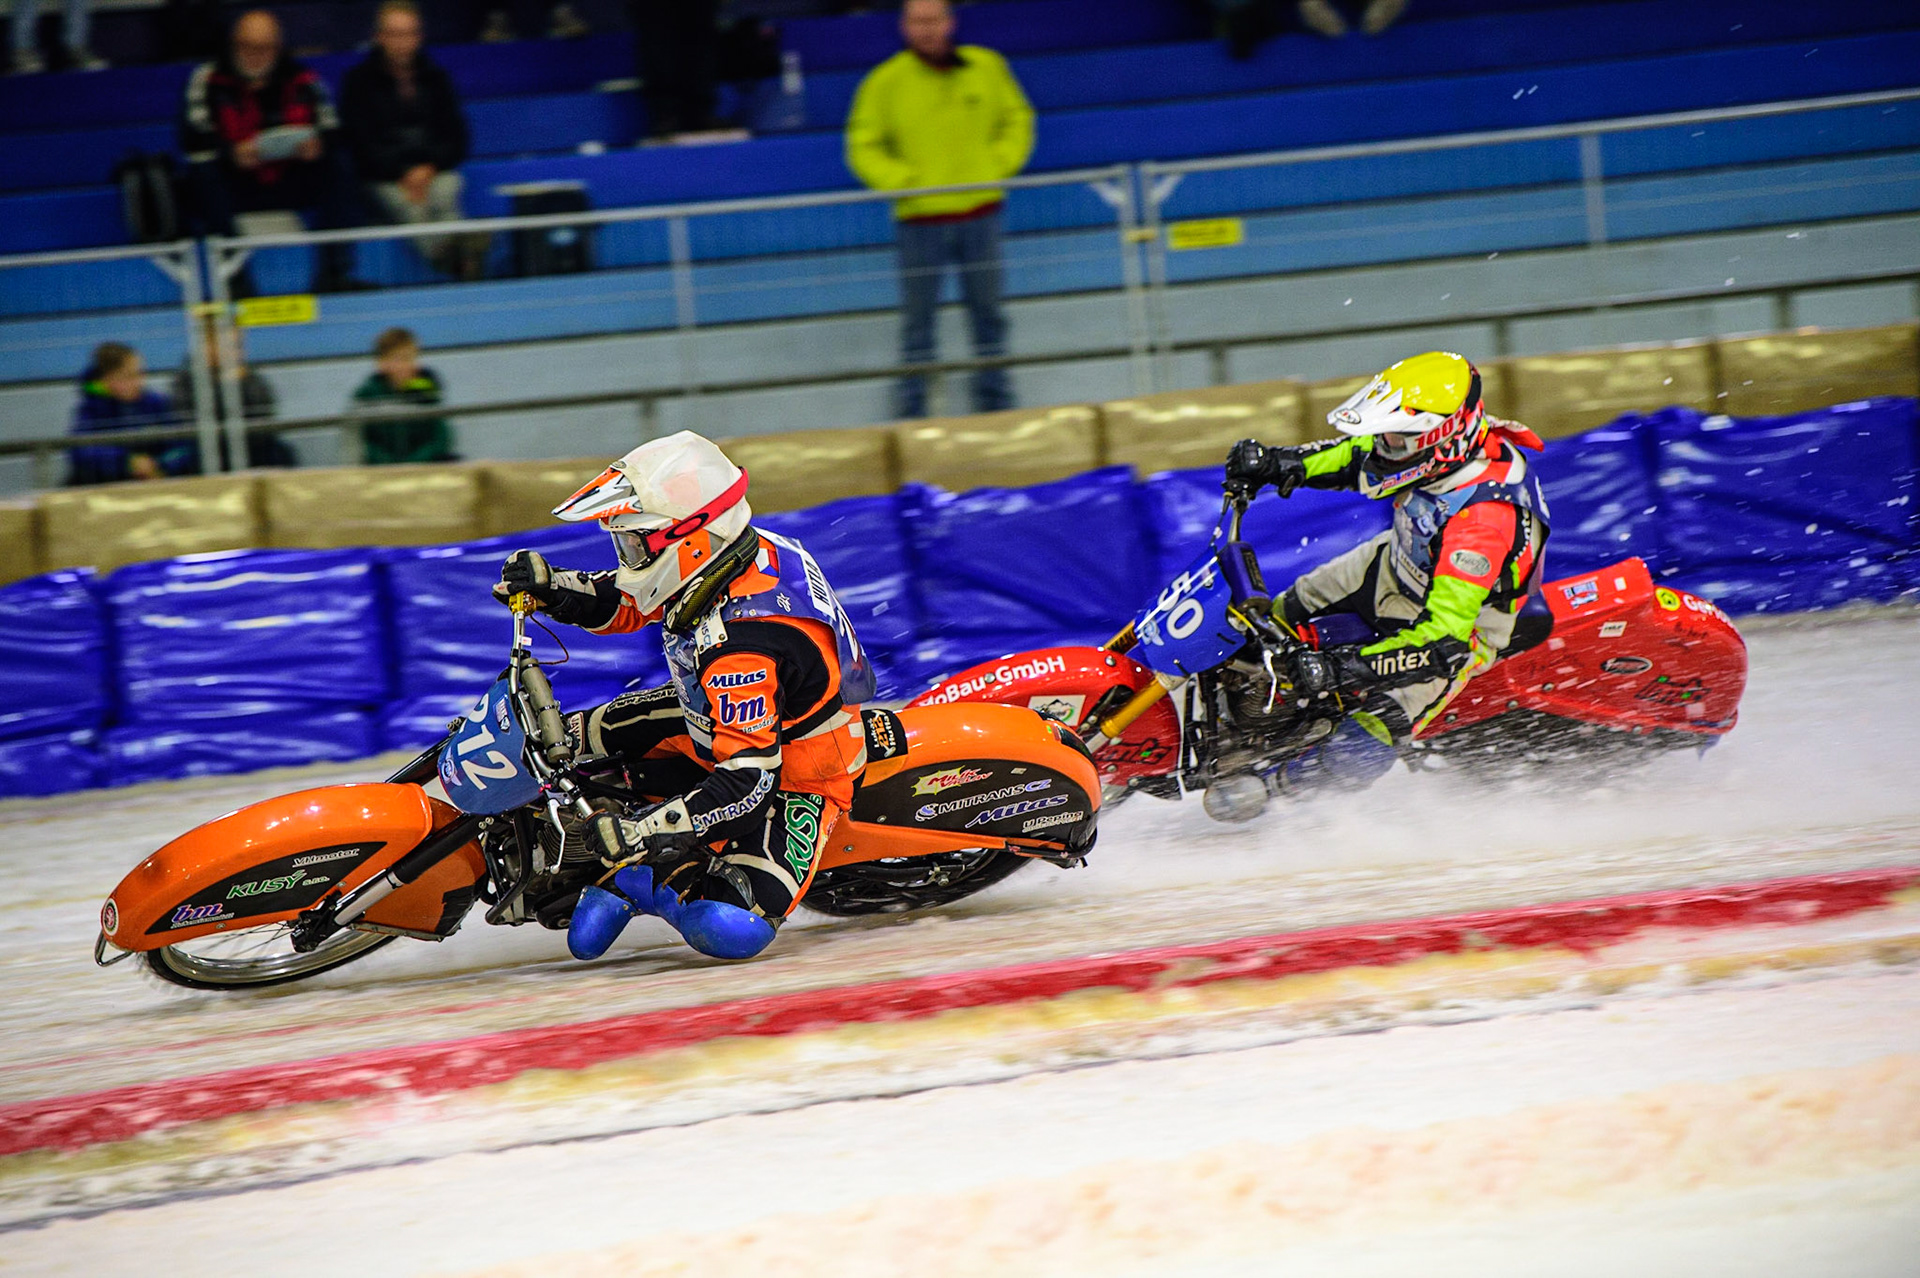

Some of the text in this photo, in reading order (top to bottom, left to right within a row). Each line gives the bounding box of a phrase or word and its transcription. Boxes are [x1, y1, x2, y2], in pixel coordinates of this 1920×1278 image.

[995, 655, 1066, 683] GmbH
[1370, 649, 1432, 676] intex
[706, 668, 767, 688] Mitas
[684, 707, 712, 727] Hertz
[717, 692, 767, 726] bm
[457, 692, 518, 790] 212
[965, 794, 1069, 829] Mitas
[171, 903, 223, 923] bm
